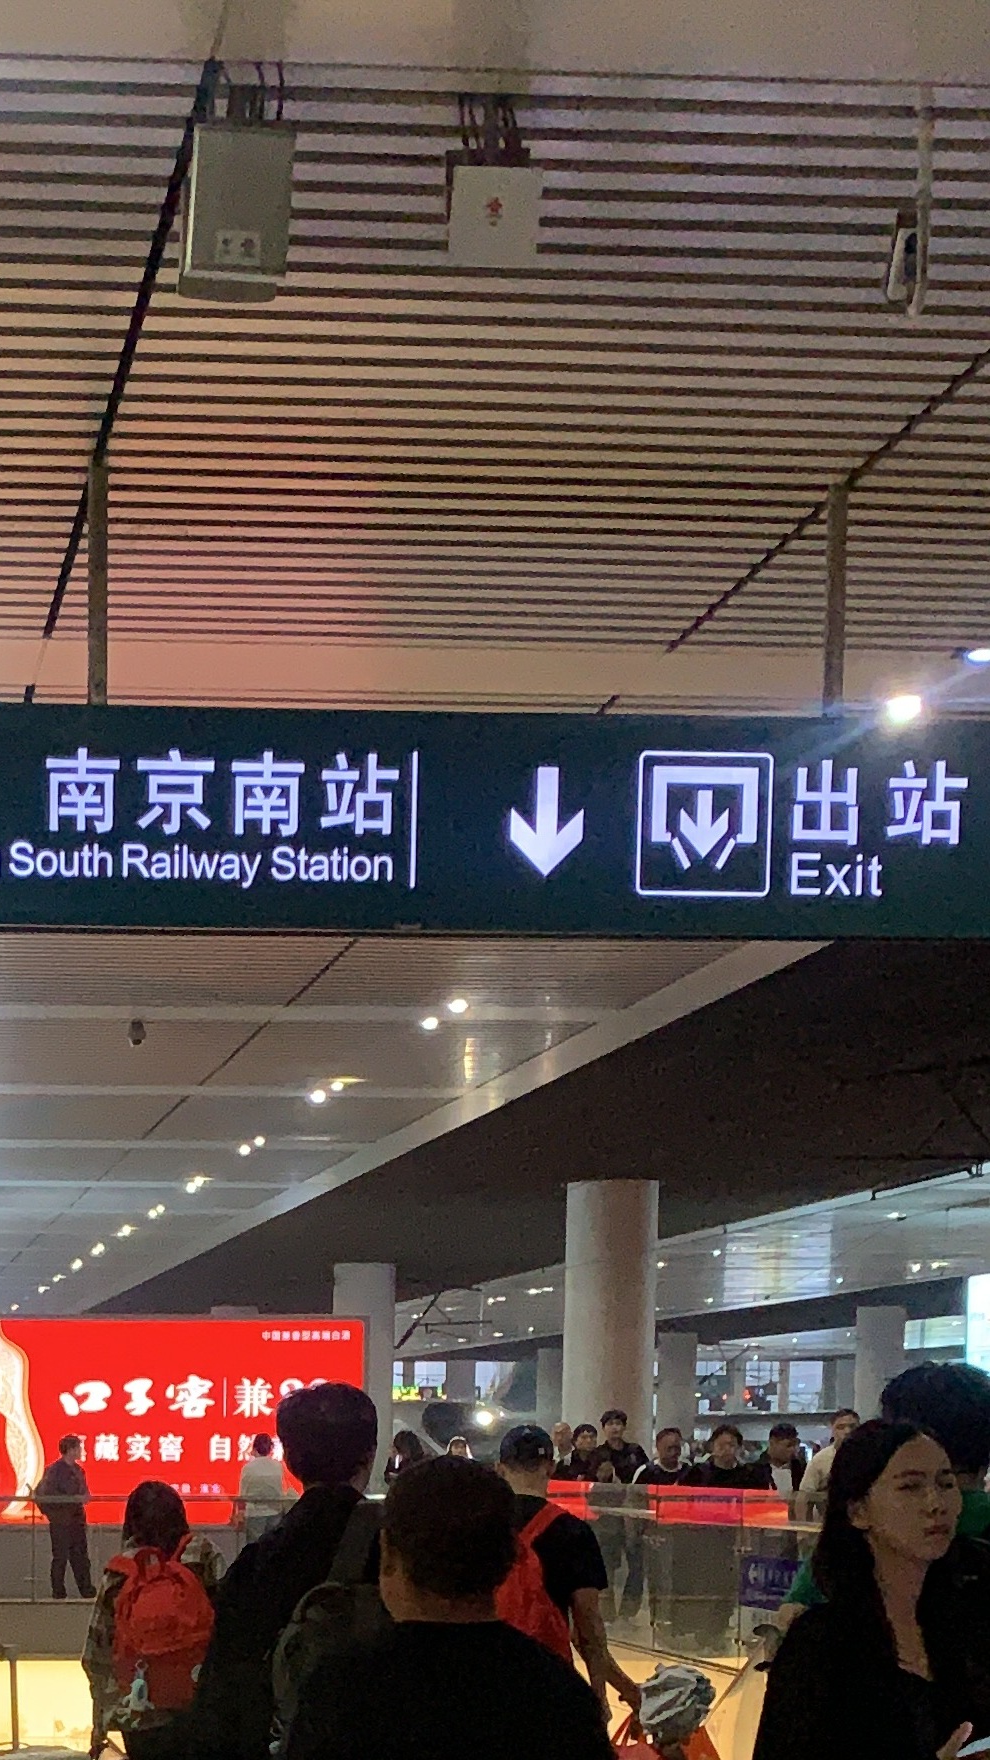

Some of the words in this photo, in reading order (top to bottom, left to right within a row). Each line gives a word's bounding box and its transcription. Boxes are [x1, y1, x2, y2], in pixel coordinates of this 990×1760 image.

[45, 748, 400, 837] 南京南站
[792, 759, 969, 847] 出站
[9, 841, 113, 879] South
[121, 844, 263, 889] Railway
[271, 846, 394, 883] Station
[791, 853, 884, 898] Exit
